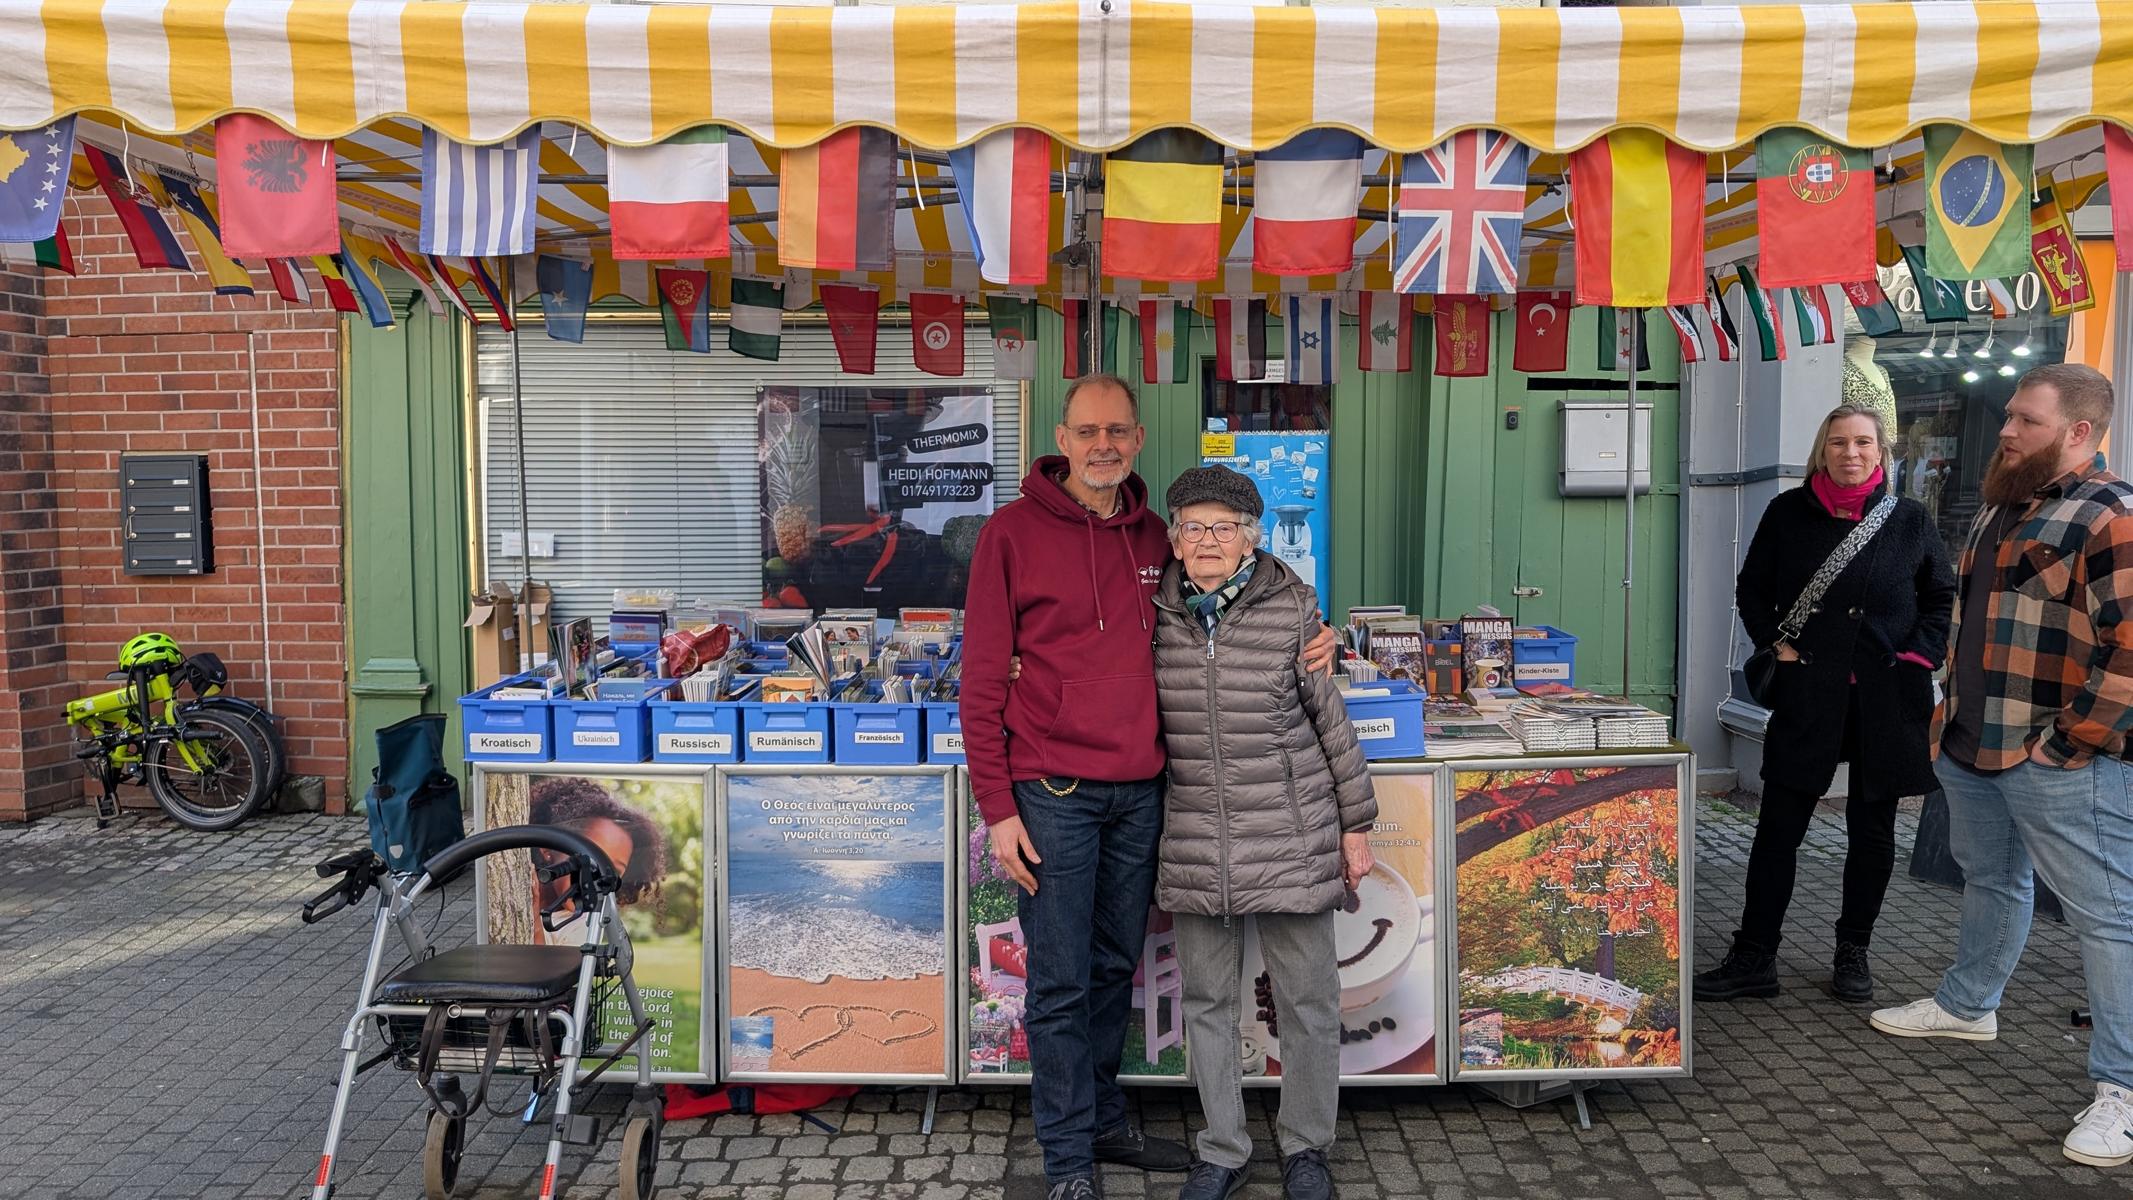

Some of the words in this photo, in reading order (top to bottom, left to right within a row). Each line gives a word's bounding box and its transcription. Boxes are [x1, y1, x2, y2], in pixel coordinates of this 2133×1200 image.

[912, 429, 979, 449] THERMOMIX
[888, 468, 922, 481] HEIDI
[925, 468, 988, 481] HOFMANN
[901, 485, 976, 498] 01749173223
[1463, 621, 1513, 634] MANGA
[1372, 636, 1421, 648] MANGA
[1481, 632, 1513, 640] MESSIAS
[1390, 645, 1422, 653] MESSIAS
[1518, 667, 1560, 675] Kinder-Kiste
[1354, 722, 1390, 734] esisch
[480, 737, 532, 749] Kroatisch
[577, 734, 615, 744] Ukrainisch
[670, 738, 720, 749] Russisch
[756, 735, 816, 747] Rumänisch
[858, 733, 901, 742] Französisch
[947, 738, 966, 750] Eng
[773, 800, 804, 812] Θεός
[806, 800, 835, 811] είναι
[837, 800, 915, 812] μεγαλύτερος
[768, 815, 793, 827] από
[795, 816, 816, 827] την
[818, 815, 861, 827] καρδιά
[863, 817, 888, 828] μας
[888, 816, 907, 826] και
[1373, 820, 1402, 834] ğım.
[783, 829, 834, 842] γνωρίζει
[837, 831, 851, 840] τα
[852, 829, 894, 840] πάντα.
[1368, 840, 1393, 848] remya
[636, 986, 674, 1000] ejoice
[617, 1000, 631, 1011] th
[642, 1002, 673, 1015] Lord,
[613, 1014, 635, 1026] wil
[661, 1016, 673, 1028] in
[608, 1028, 629, 1040] the
[659, 1031, 674, 1046] of
